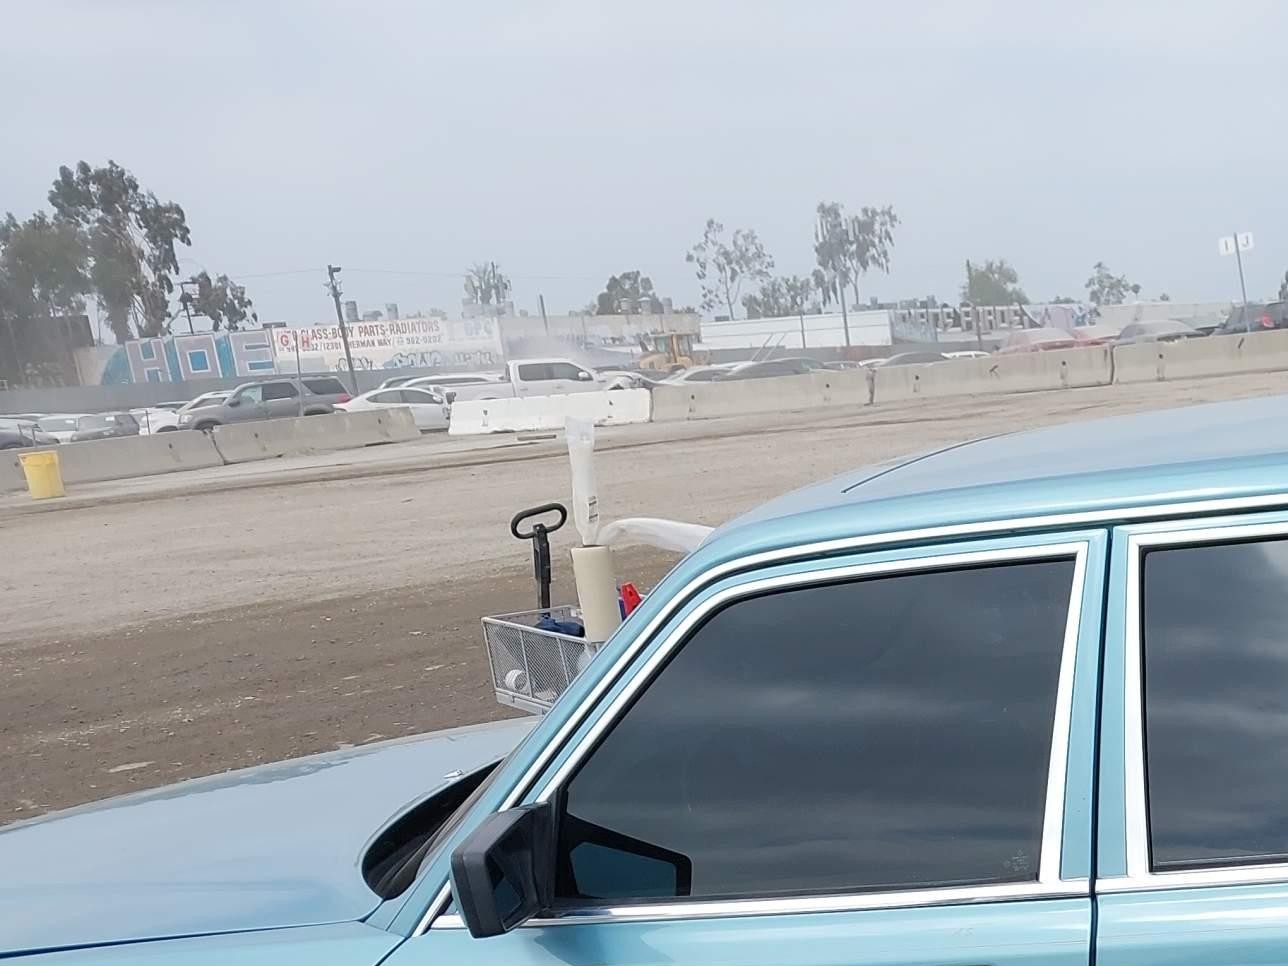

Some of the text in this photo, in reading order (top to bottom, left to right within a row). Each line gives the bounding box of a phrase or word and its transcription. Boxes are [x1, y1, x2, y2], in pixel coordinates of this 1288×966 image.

[1241, 235, 1249, 248] J
[300, 326, 354, 341] ASS-BOY
[358, 319, 440, 338] PARTS-RADIATORS
[280, 334, 289, 346] G
[301, 336, 310, 348] H
